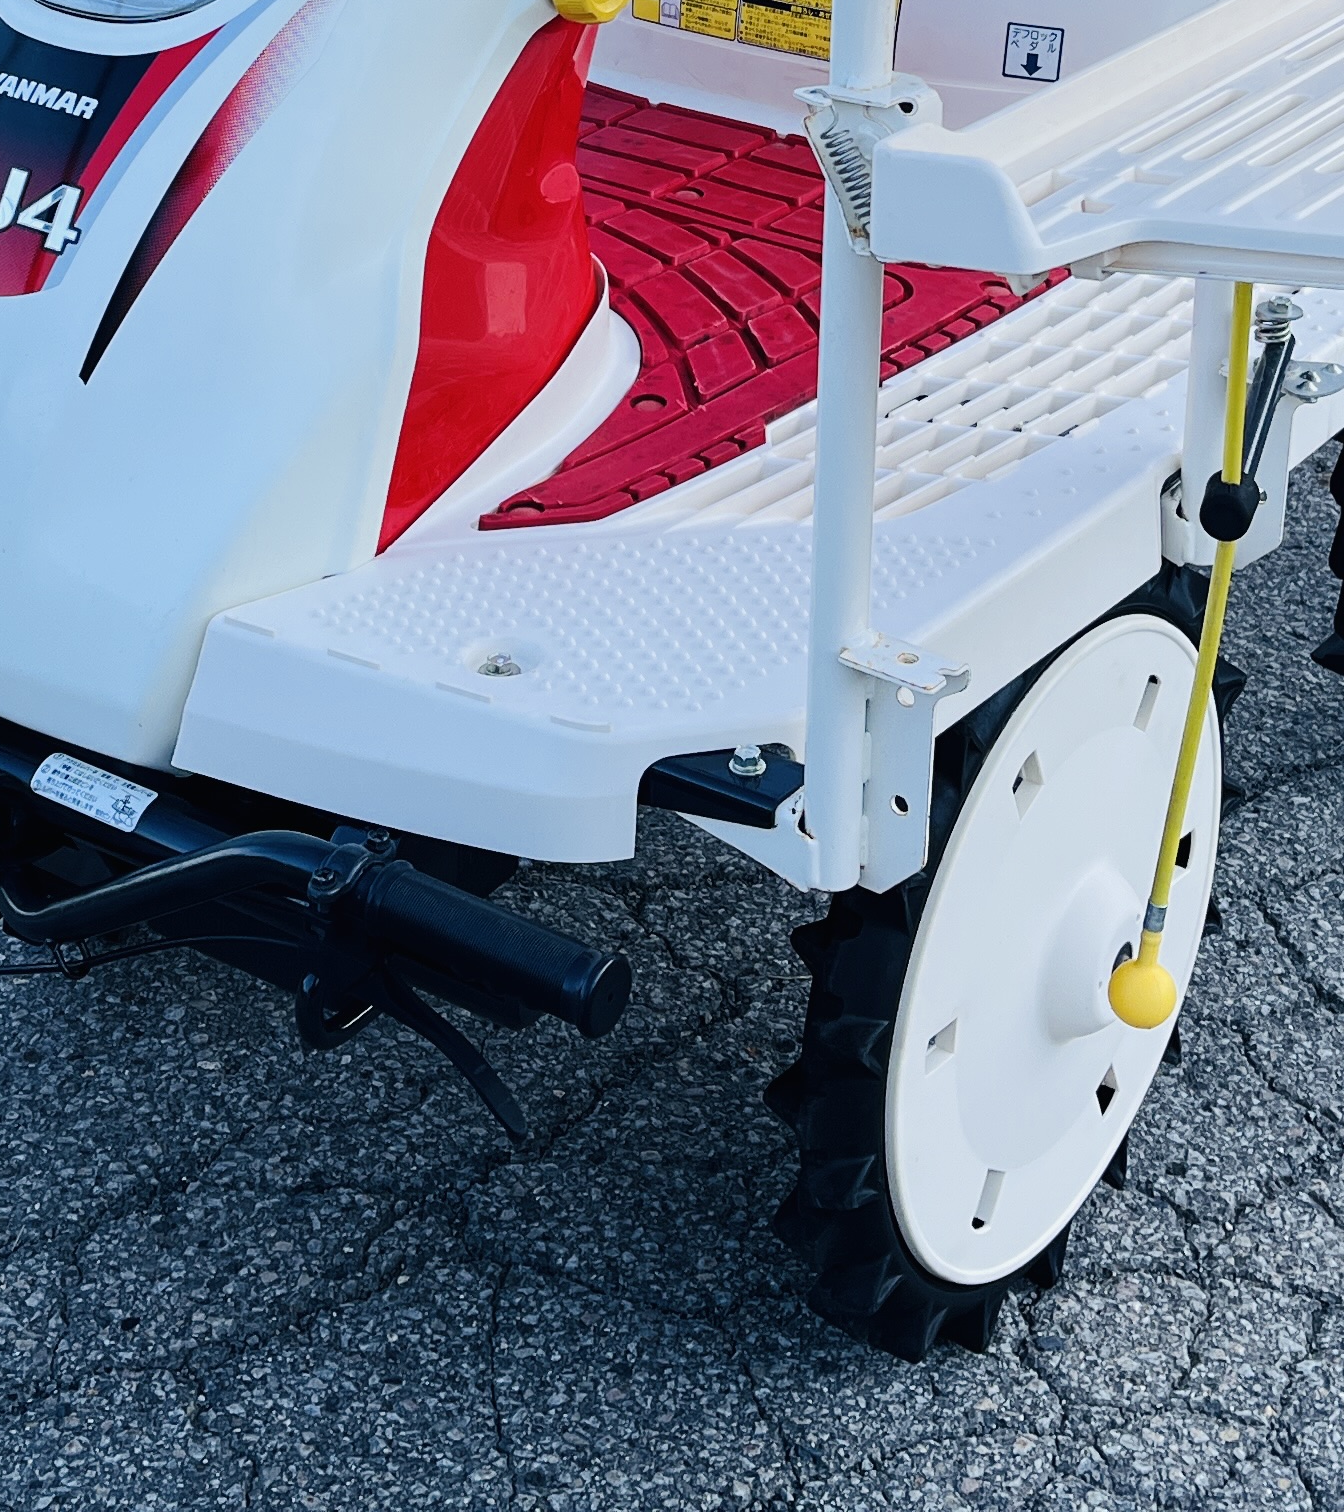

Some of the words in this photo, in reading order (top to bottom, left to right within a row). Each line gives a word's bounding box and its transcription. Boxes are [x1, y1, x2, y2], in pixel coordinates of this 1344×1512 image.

[1012, 27, 1058, 43] デフロック
